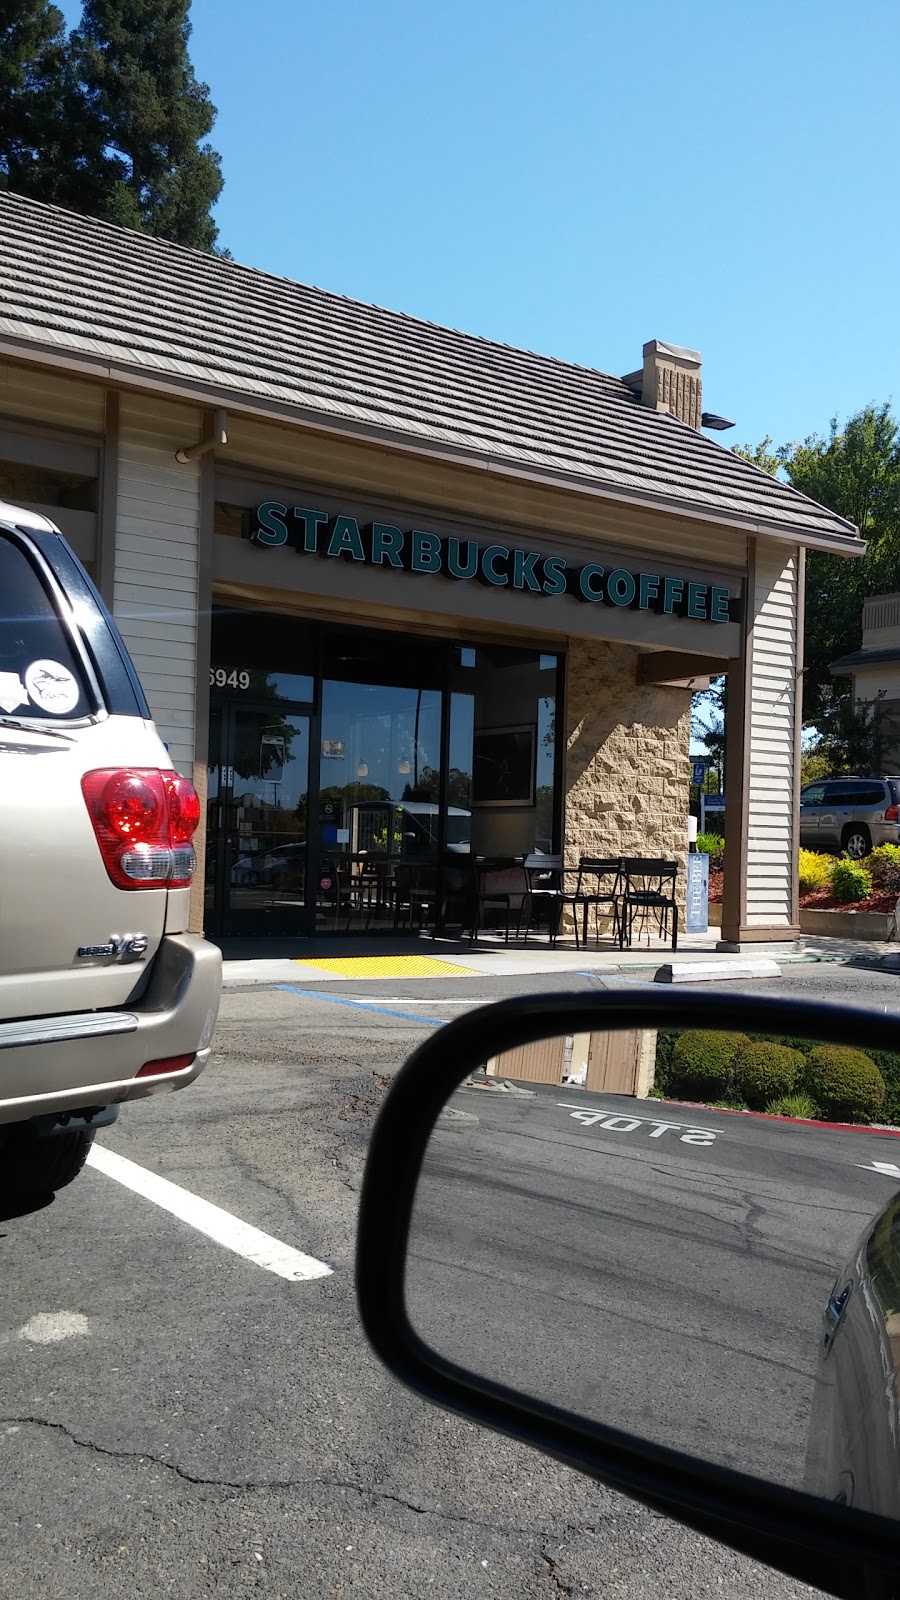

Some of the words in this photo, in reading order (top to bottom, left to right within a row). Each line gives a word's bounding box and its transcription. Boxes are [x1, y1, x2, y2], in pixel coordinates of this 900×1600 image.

[255, 501, 567, 596] STARBUCKS
[579, 563, 731, 623] COFFEE
[692, 855, 702, 883] BEE
[691, 881, 702, 918] THE
